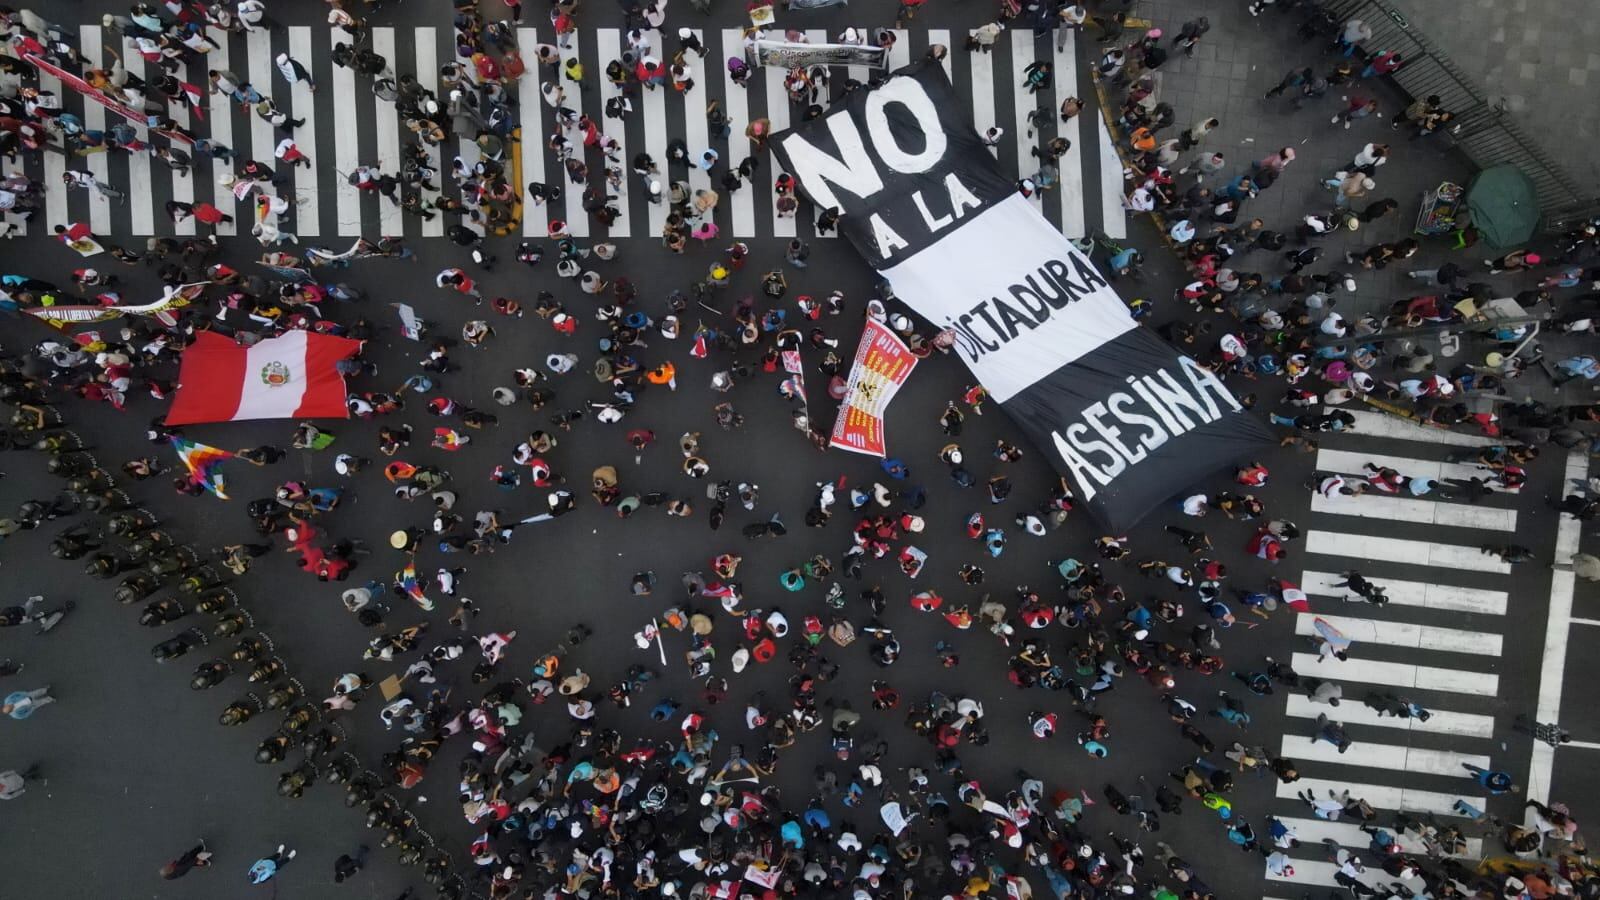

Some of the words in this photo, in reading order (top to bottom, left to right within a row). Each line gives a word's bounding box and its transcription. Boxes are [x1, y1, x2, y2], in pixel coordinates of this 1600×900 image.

[782, 75, 947, 214] NO
[869, 213, 909, 259] A
[912, 172, 982, 232] LA
